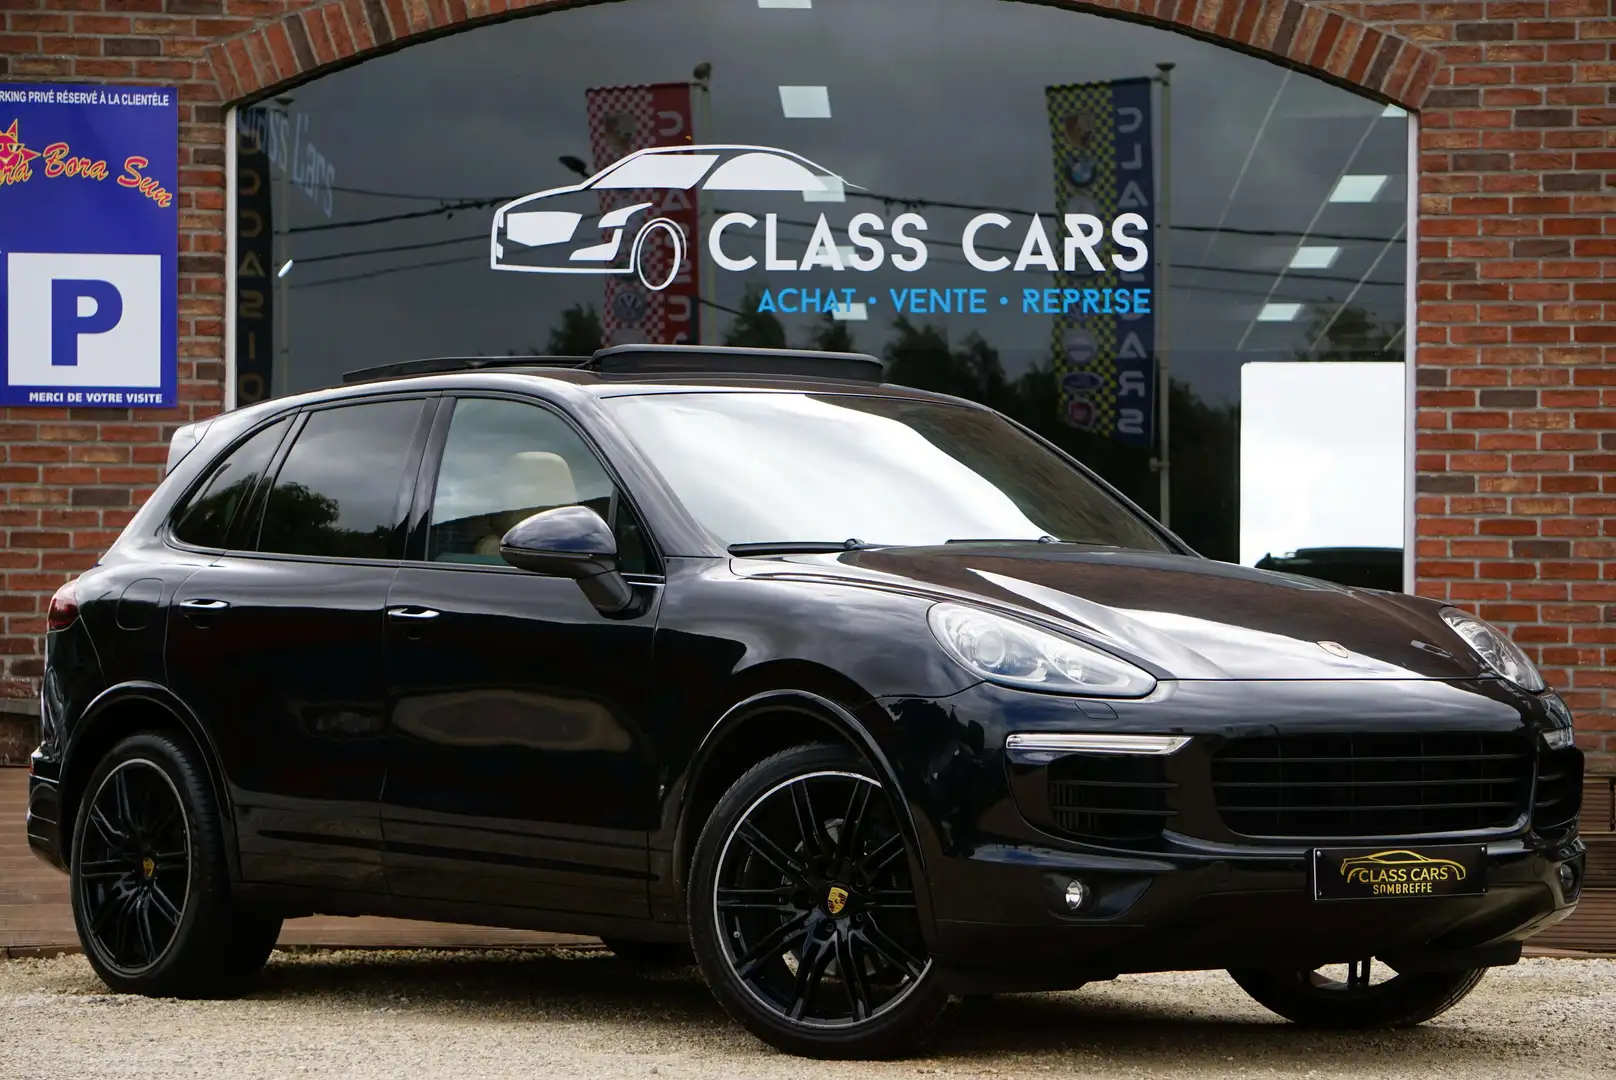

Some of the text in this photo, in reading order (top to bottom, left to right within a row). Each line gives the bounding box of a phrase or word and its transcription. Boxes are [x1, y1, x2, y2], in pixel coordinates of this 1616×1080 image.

[28, 89, 55, 104] PRIVÉ
[56, 90, 98, 105] RÉSERVÉ
[108, 93, 120, 105] LA
[43, 142, 109, 181] Bora
[117, 155, 173, 208] Sun
[708, 212, 1149, 272] CLASS CARS
[756, 288, 1151, 314] ACHAT VENTE REPRISE
[51, 279, 123, 367] P
[29, 392, 163, 404] MERCI DE VOTRE VISITE
[1358, 867, 1449, 883] CLASS CARS
[1373, 882, 1433, 895] SOMBREFFE
